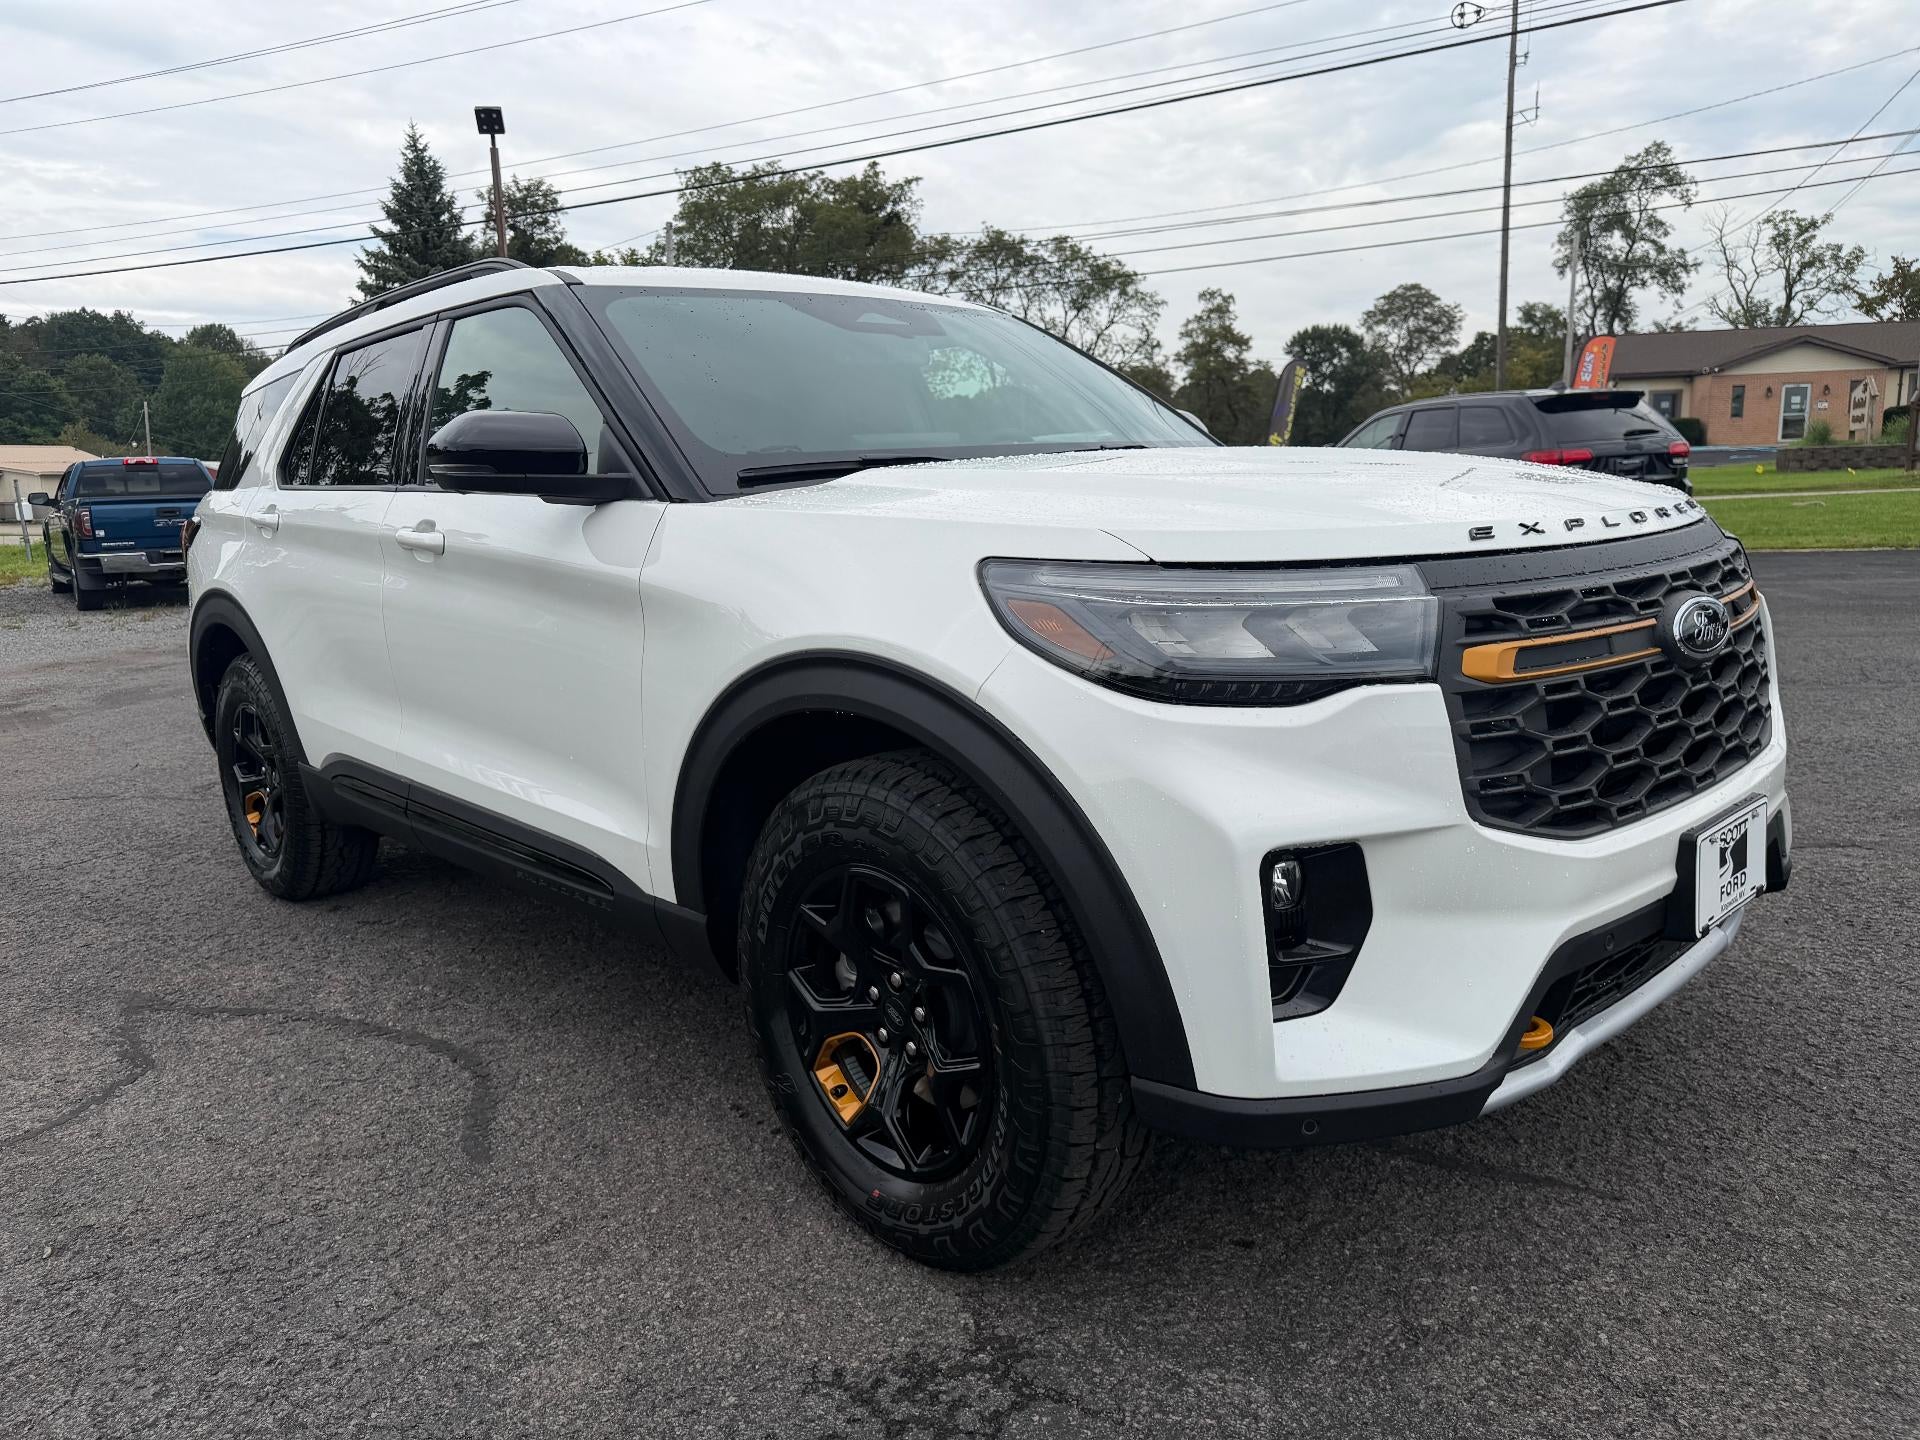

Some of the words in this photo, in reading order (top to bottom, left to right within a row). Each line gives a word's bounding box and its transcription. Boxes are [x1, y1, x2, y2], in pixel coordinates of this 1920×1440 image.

[1468, 499, 1698, 541] EXPLORER
[1719, 818, 1749, 847] SCOTT
[1720, 871, 1747, 903] FORD
